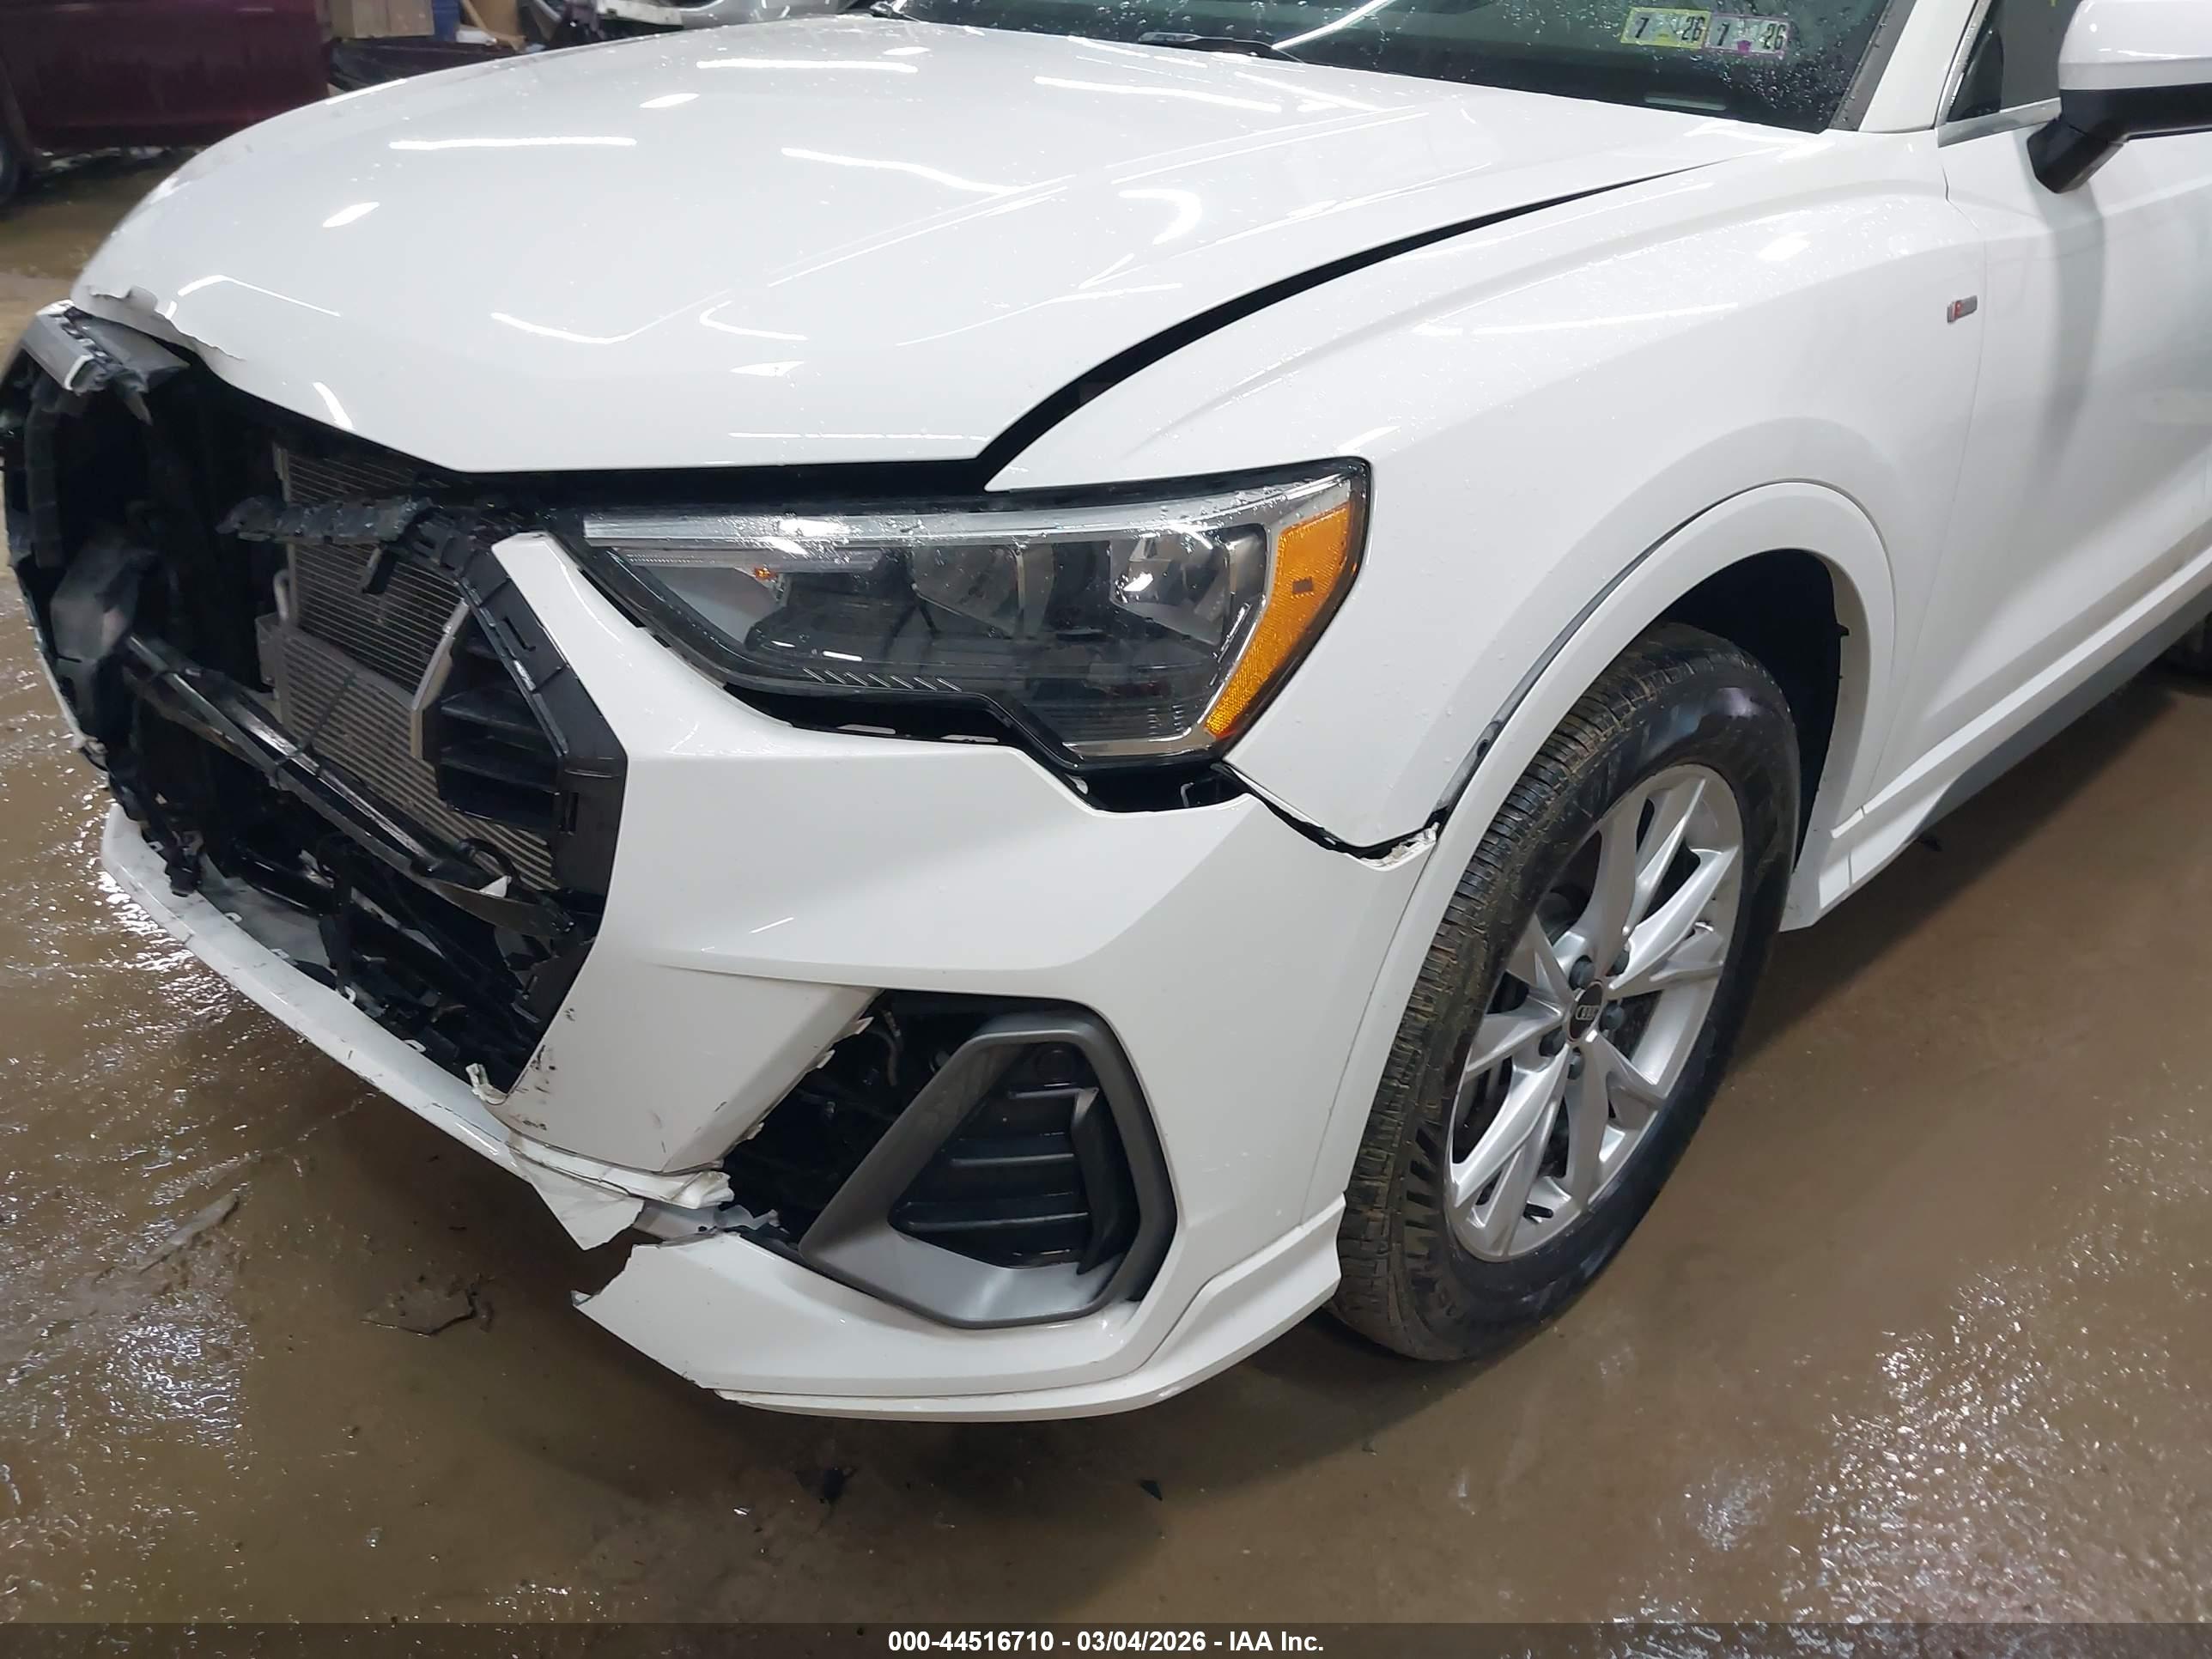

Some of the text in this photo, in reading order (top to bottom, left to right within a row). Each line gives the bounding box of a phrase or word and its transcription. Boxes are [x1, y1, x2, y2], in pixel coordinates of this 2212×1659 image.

[1635, 15, 1705, 41] 7 26
[1717, 22, 1786, 50] 7 26
